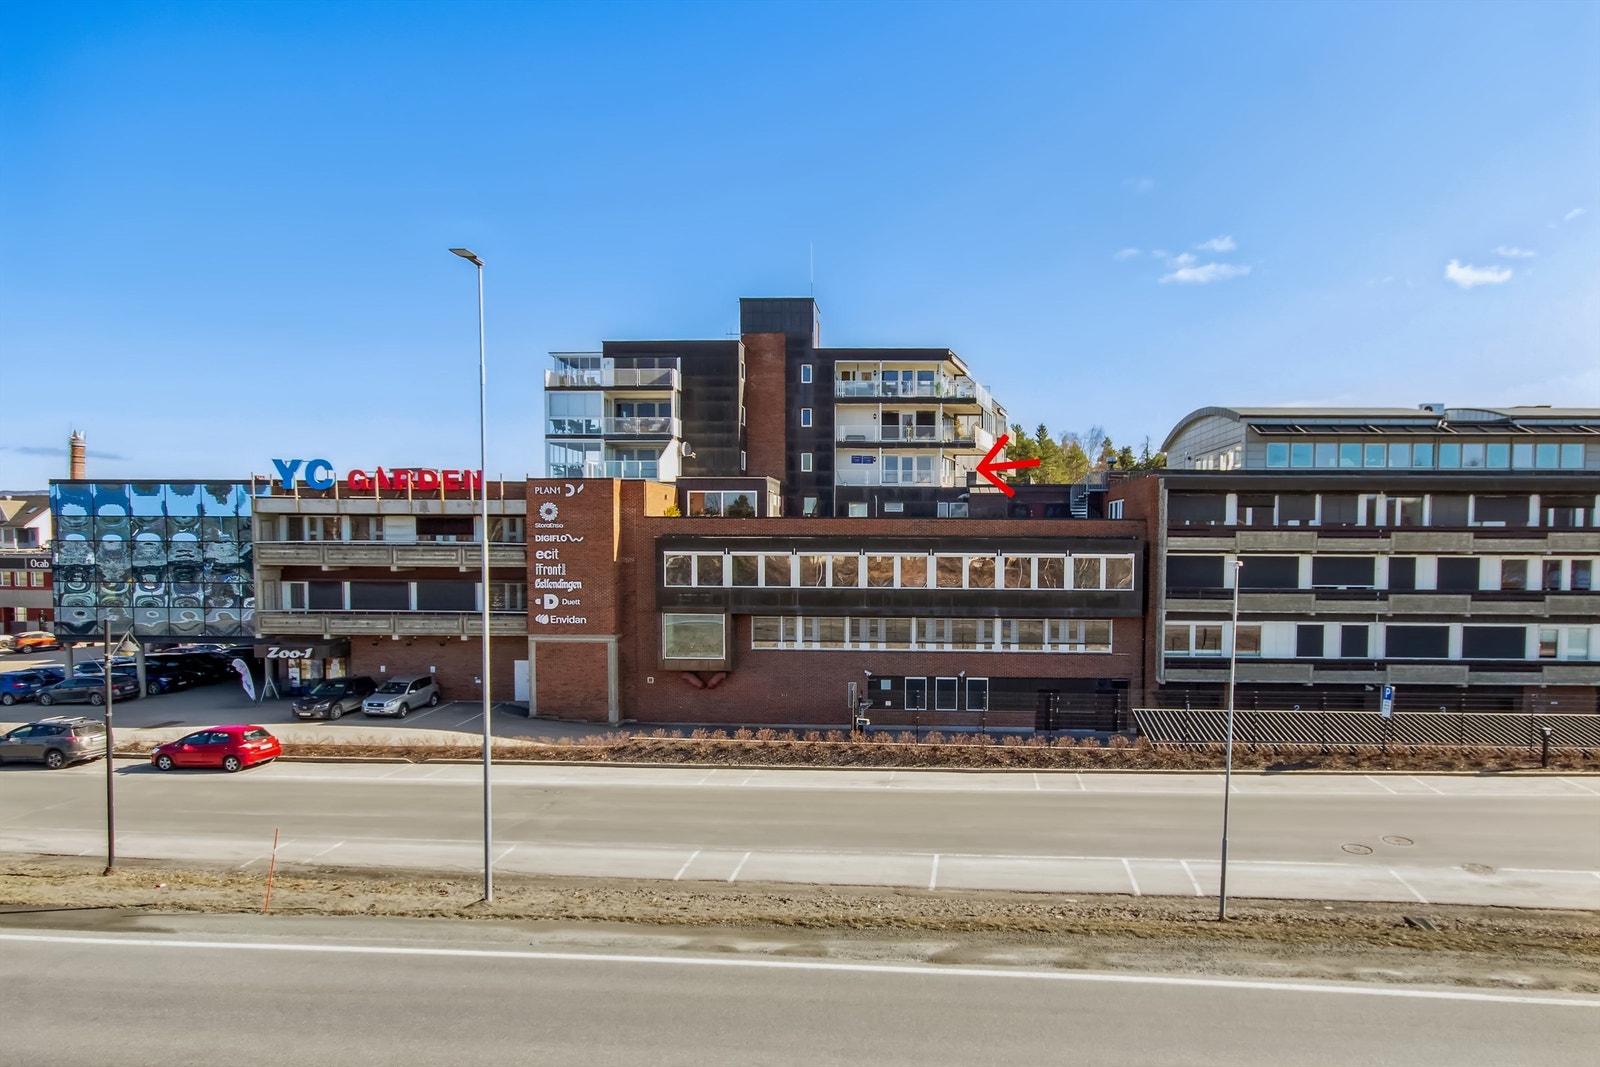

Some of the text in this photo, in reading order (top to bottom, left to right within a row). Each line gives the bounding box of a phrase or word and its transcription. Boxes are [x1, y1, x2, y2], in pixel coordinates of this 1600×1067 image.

[272, 458, 335, 491] YC
[534, 486, 561, 495] PLAN1
[535, 548, 559, 559] ecit
[30, 559, 49, 568] Ocab
[550, 615, 587, 624] Envidan
[266, 646, 313, 659] Zoo-1
